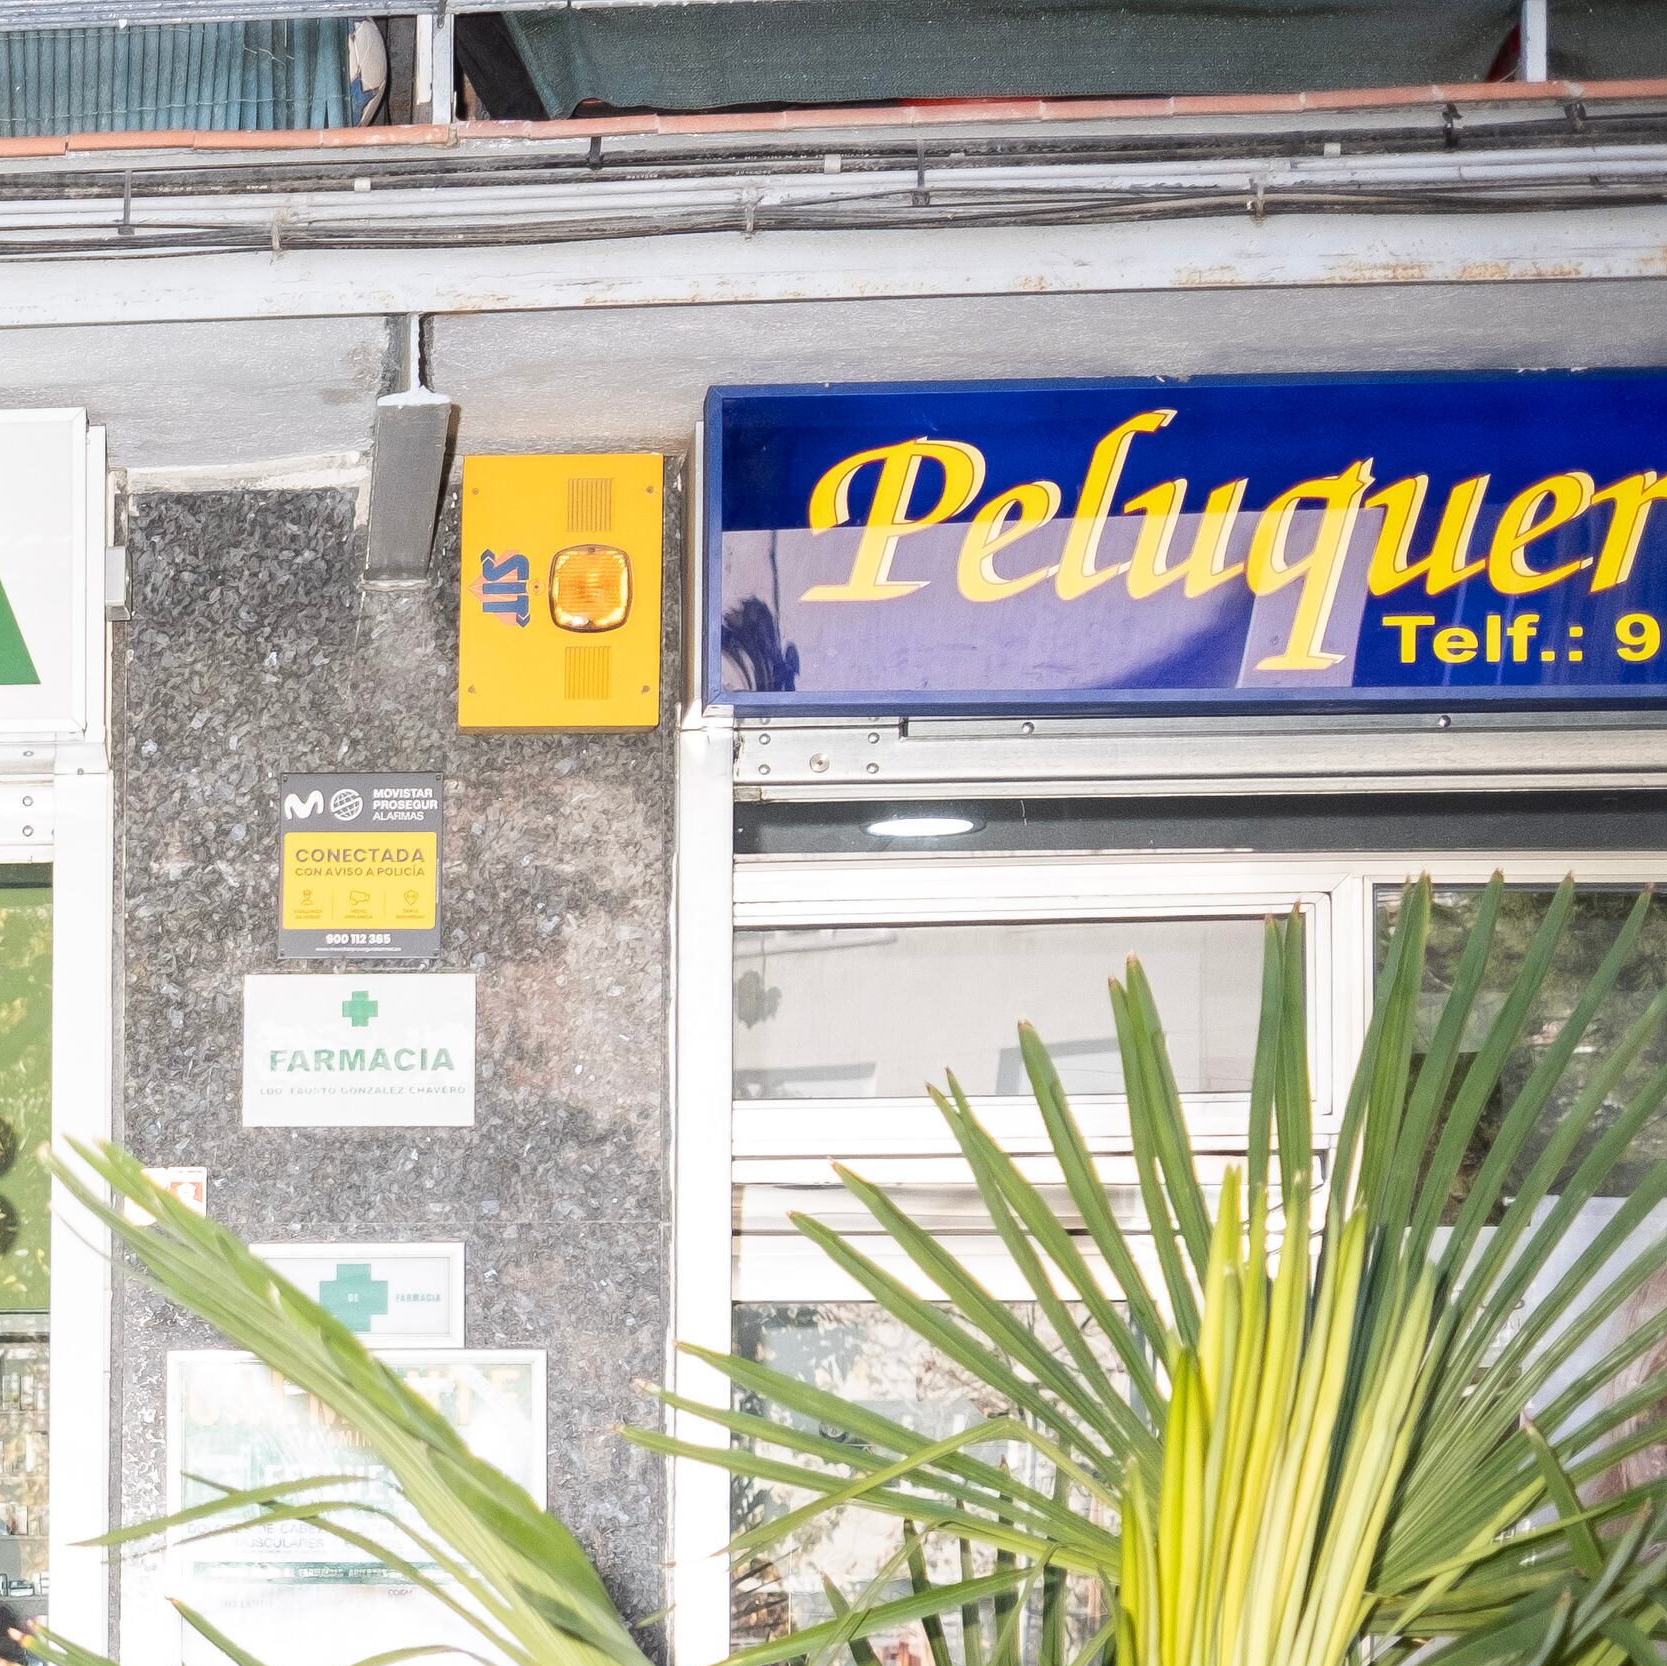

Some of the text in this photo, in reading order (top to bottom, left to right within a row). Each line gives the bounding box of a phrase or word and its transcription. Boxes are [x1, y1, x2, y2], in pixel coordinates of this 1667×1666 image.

[1383, 613, 1661, 663] Telf.: 9
[373, 788, 433, 799] MOVISTAR
[373, 800, 438, 810] PROSEGUR
[373, 812, 425, 821] ALARMAS
[295, 848, 425, 863] CONECTADA
[295, 867, 322, 877] CON
[325, 867, 363, 876] AVISO
[377, 865, 425, 877] POLICÍA
[326, 933, 349, 945] 900
[351, 933, 367, 944] 112
[269, 1048, 455, 1072] FARMACIA
[290, 1087, 336, 1095] FAUSTO
[341, 1086, 404, 1095] GONZALEZ
[409, 1086, 466, 1094] CHAVERO
[395, 1293, 441, 1302] FARMACIA
